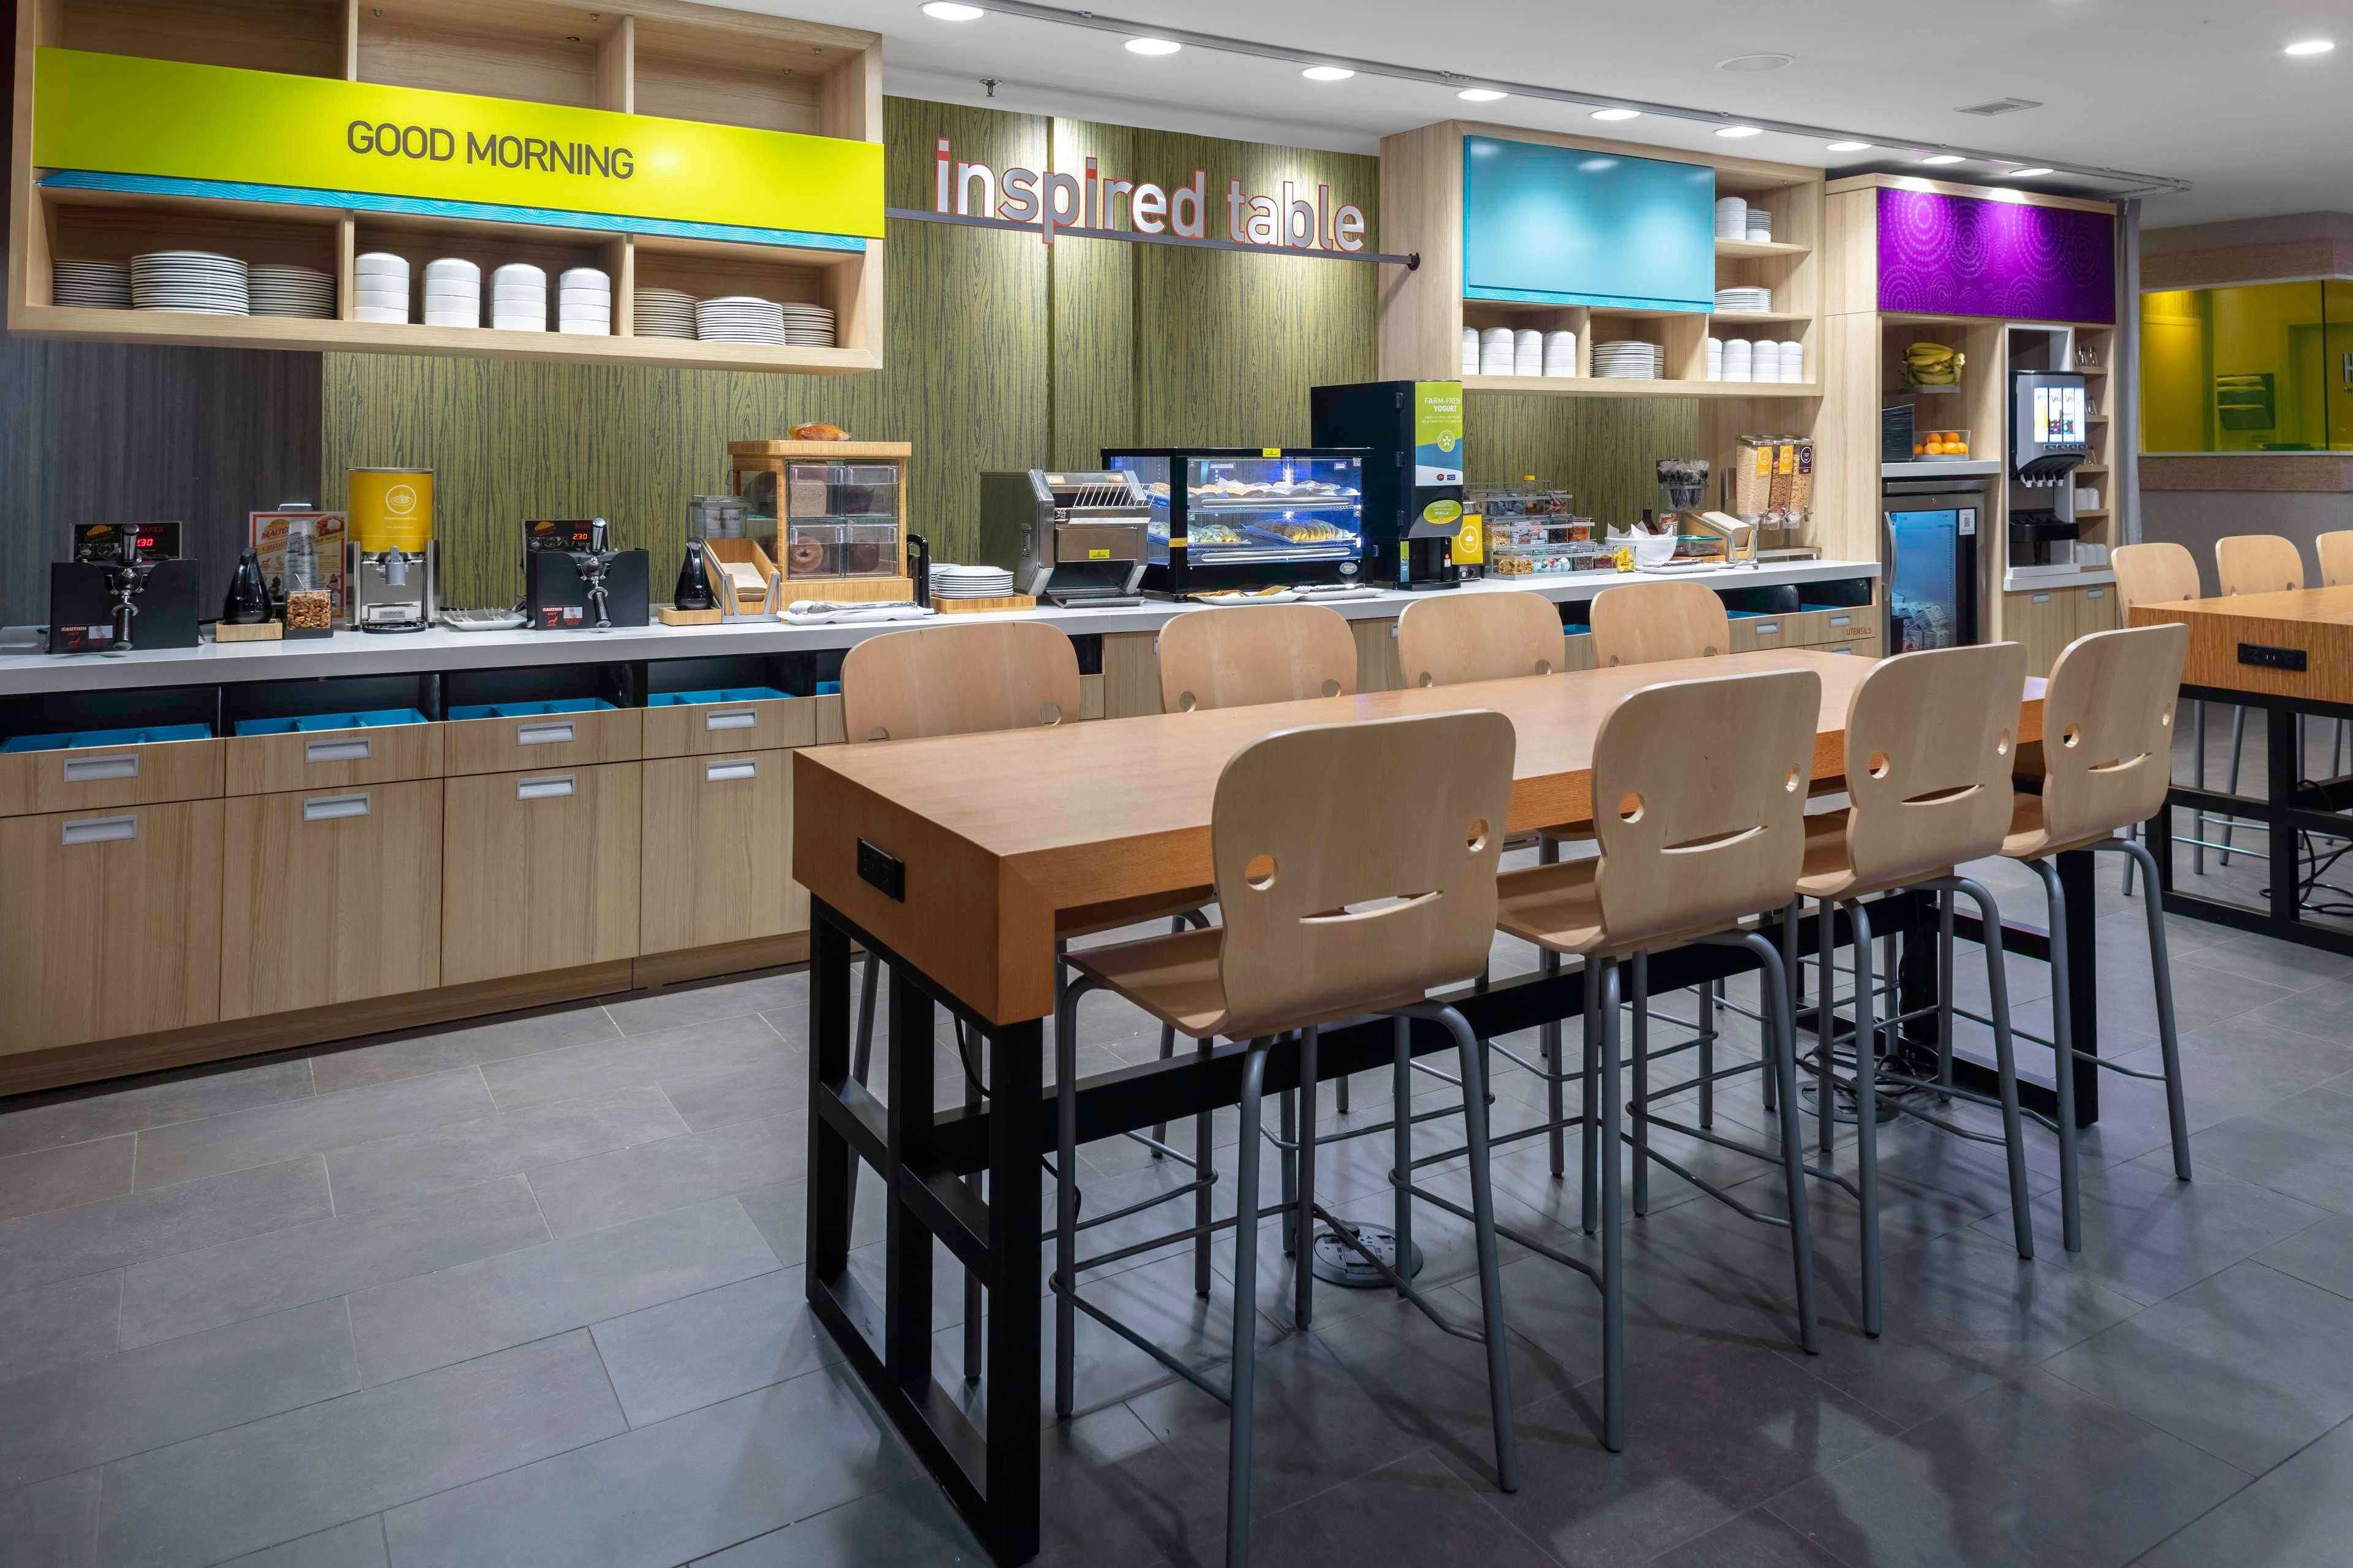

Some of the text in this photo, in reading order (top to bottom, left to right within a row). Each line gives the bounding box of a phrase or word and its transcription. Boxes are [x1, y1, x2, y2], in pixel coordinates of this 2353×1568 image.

[347, 120, 634, 180] GOOD MORNING
[937, 137, 1364, 252] inspired table
[261, 528, 289, 540] MALTE
[262, 540, 287, 552] CAUTIO
[1846, 627, 1872, 636] UTENSILS
